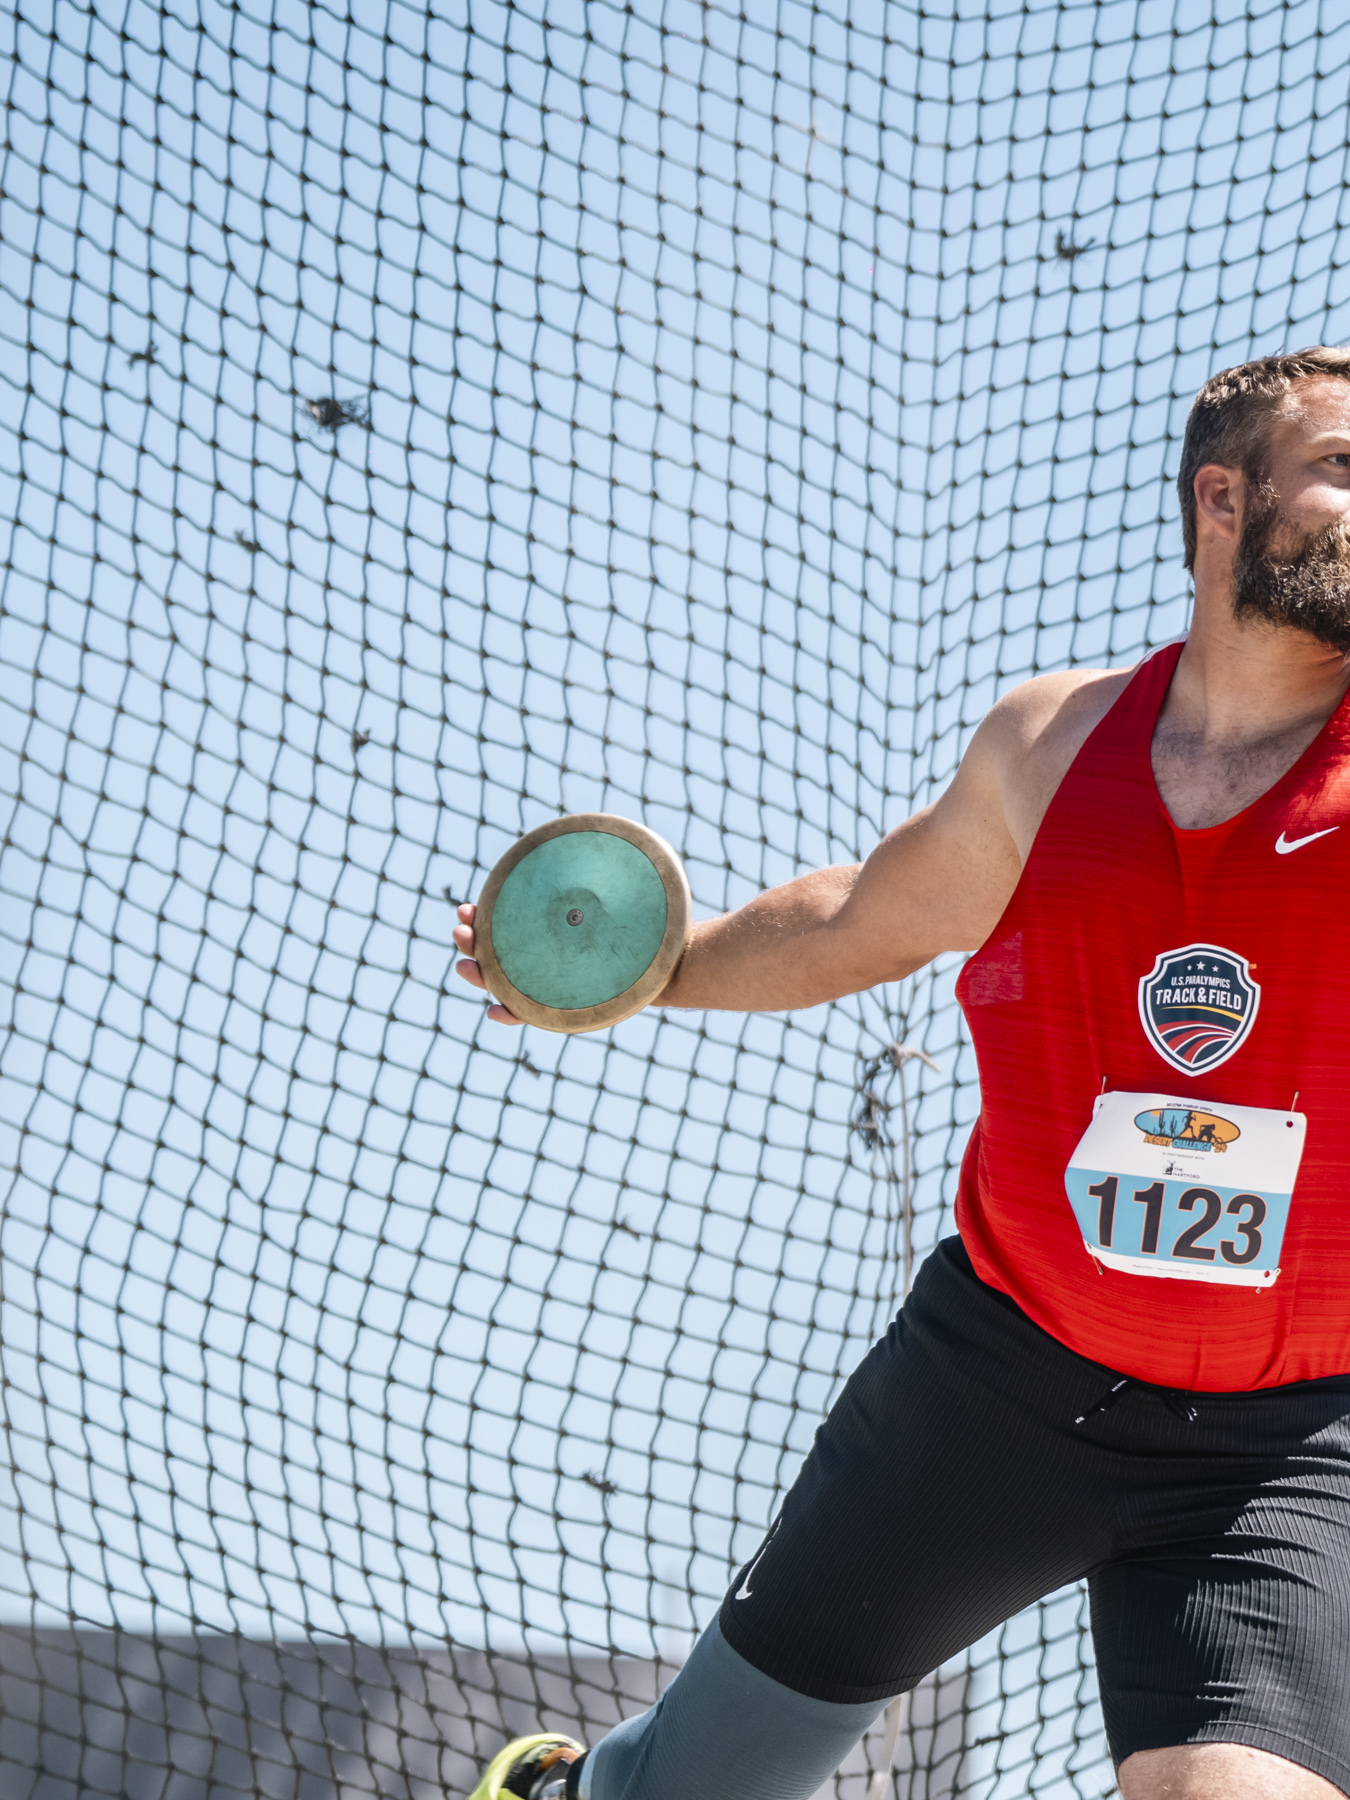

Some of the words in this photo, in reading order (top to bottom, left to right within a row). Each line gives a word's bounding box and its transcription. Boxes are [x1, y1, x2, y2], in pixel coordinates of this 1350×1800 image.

[1171, 976, 1185, 986] U.S.
[1185, 975, 1230, 988] PARALYMPICS
[1156, 988, 1196, 1005] TRACK
[1197, 986, 1207, 1003] &
[1208, 990, 1242, 1010] FIELD
[1143, 1134, 1172, 1147] DESERT
[1172, 1139, 1212, 1152] CHALLENGE
[1088, 1176, 1267, 1265] 1123
